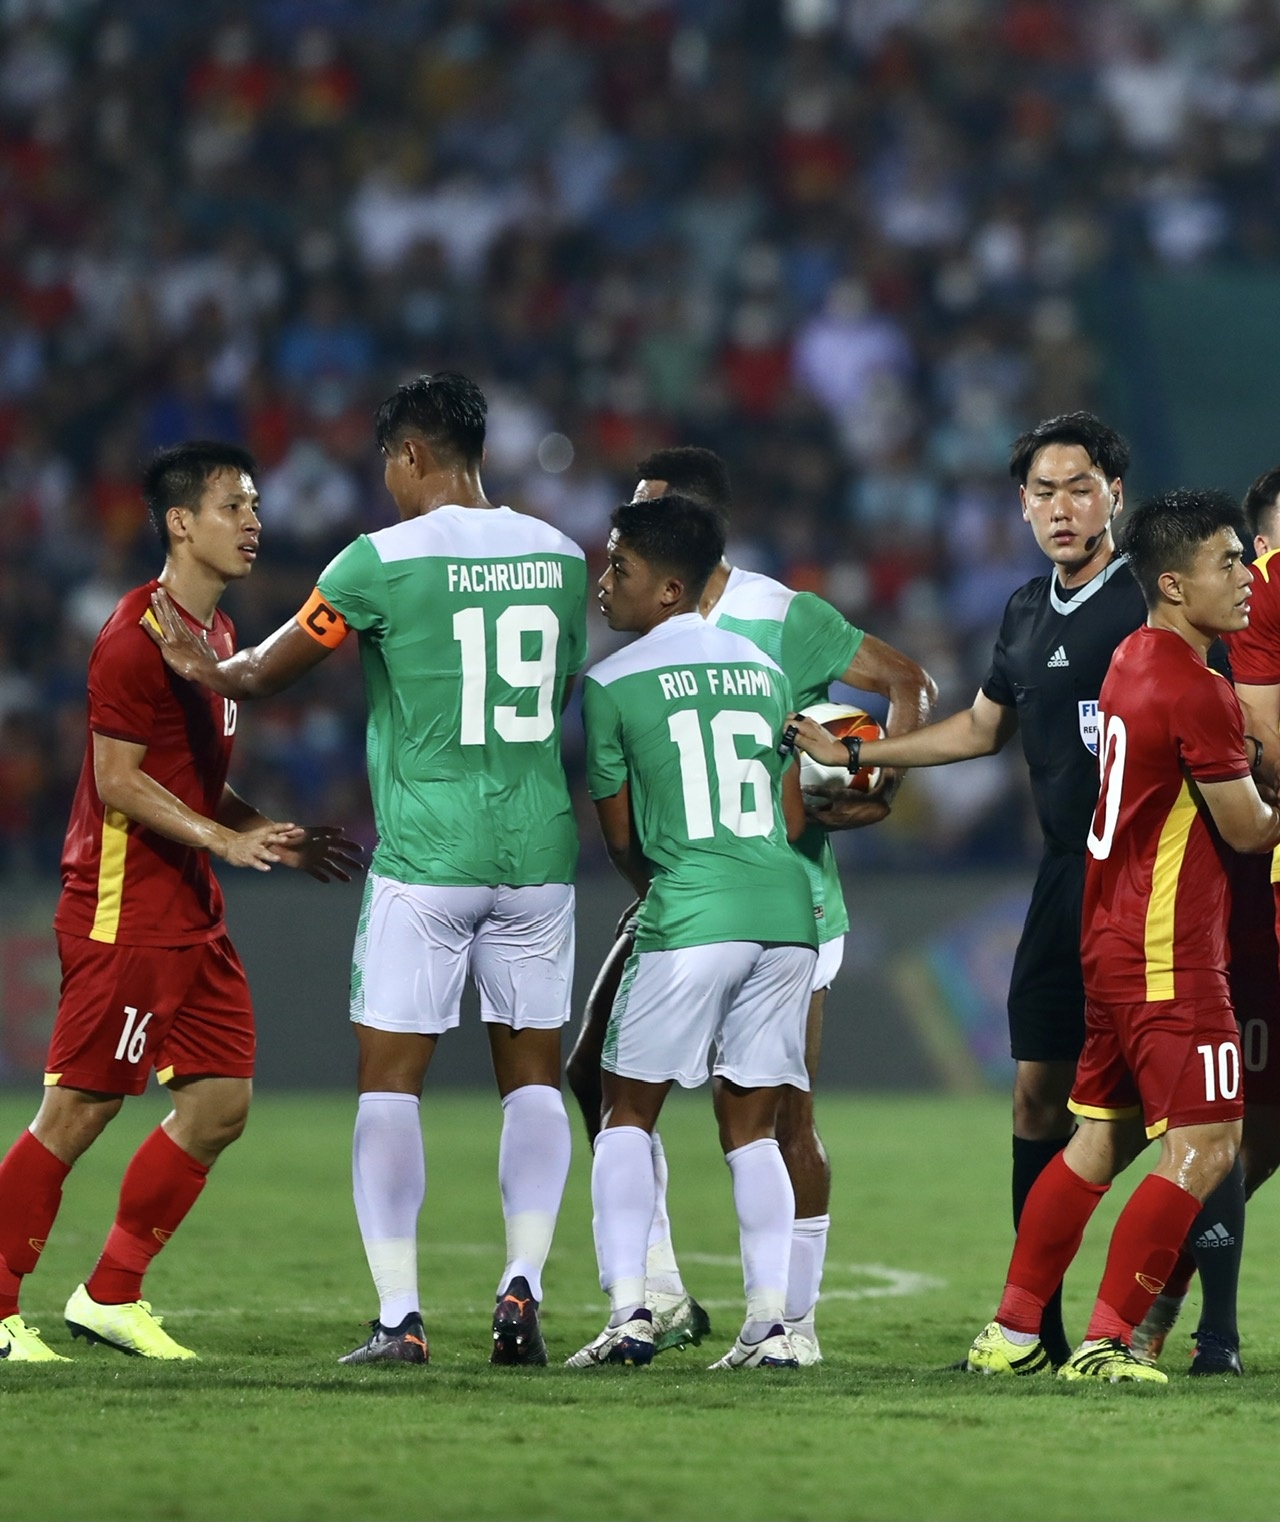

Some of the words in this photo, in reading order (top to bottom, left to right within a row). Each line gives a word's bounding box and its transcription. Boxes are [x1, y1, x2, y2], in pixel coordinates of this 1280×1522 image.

[447, 561, 563, 593] FACHRUDDIN
[306, 603, 337, 636] C
[453, 605, 560, 746] 19
[658, 670, 698, 700] RIO
[706, 669, 771, 697] FAHMI
[667, 709, 775, 840] 16
[114, 1006, 149, 1064] 16
[1197, 1041, 1240, 1102] 10
